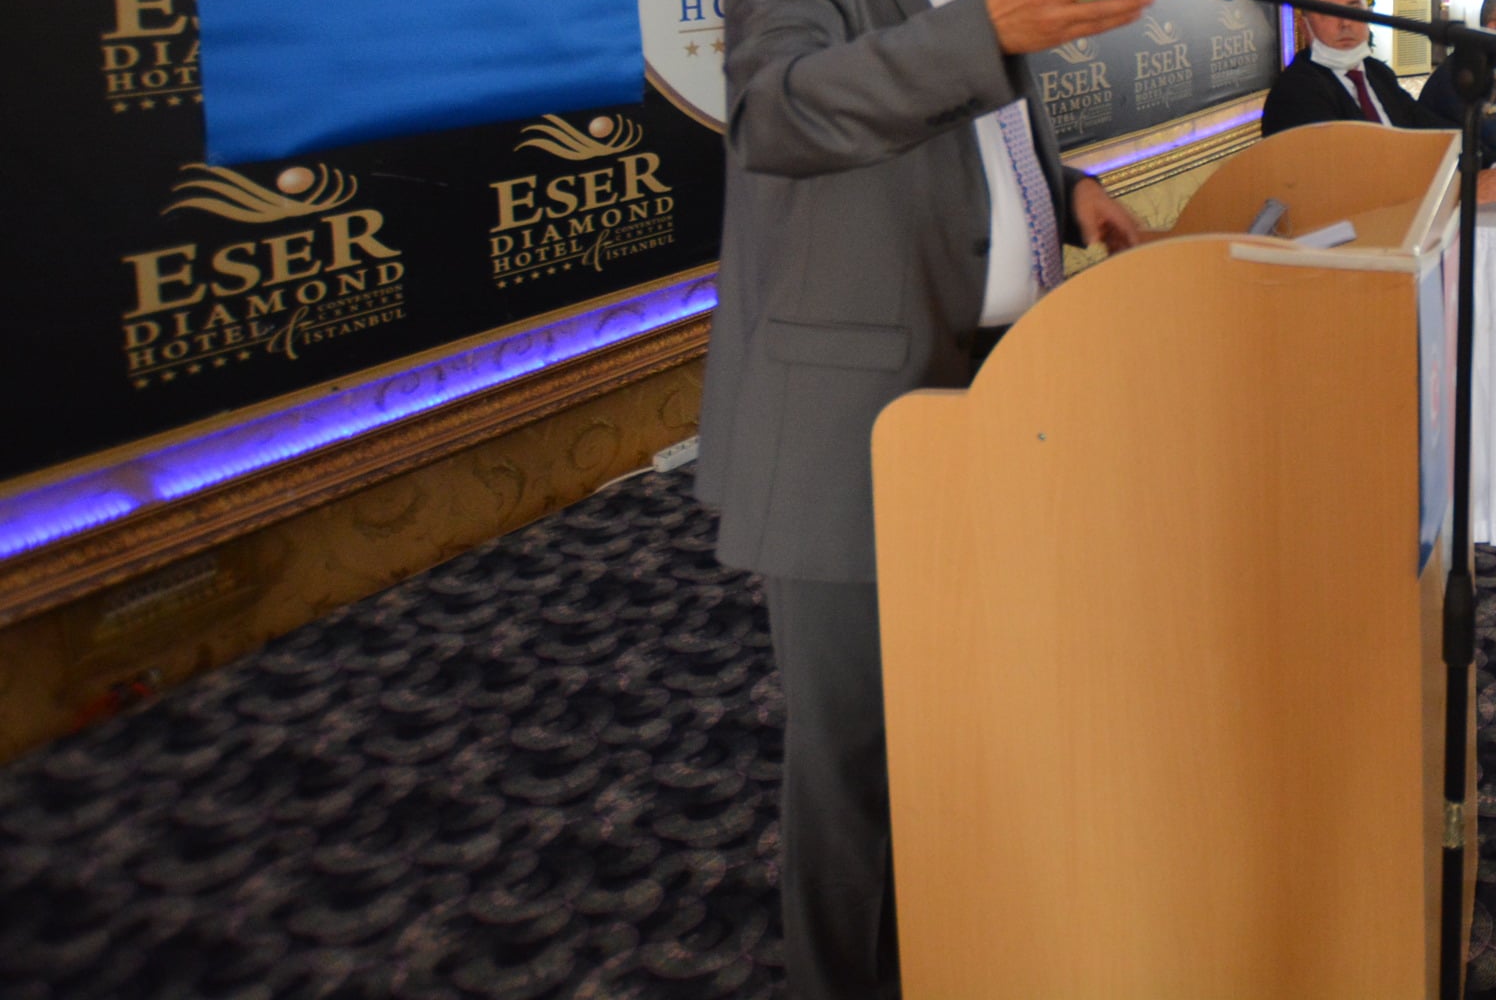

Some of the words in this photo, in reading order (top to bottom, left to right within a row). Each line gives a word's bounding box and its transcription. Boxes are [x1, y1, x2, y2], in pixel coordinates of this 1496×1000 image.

[1134, 43, 1191, 80] ESER
[1210, 30, 1258, 61] ESER
[106, 66, 198, 93] HOT
[1039, 61, 1112, 105] ESER
[489, 152, 673, 234] ESER
[490, 196, 674, 258] DIAMOND
[121, 209, 402, 320] ESER
[493, 240, 584, 274] HOTEL
[122, 261, 405, 350] DIAMOND
[128, 321, 273, 371] HOTEL
